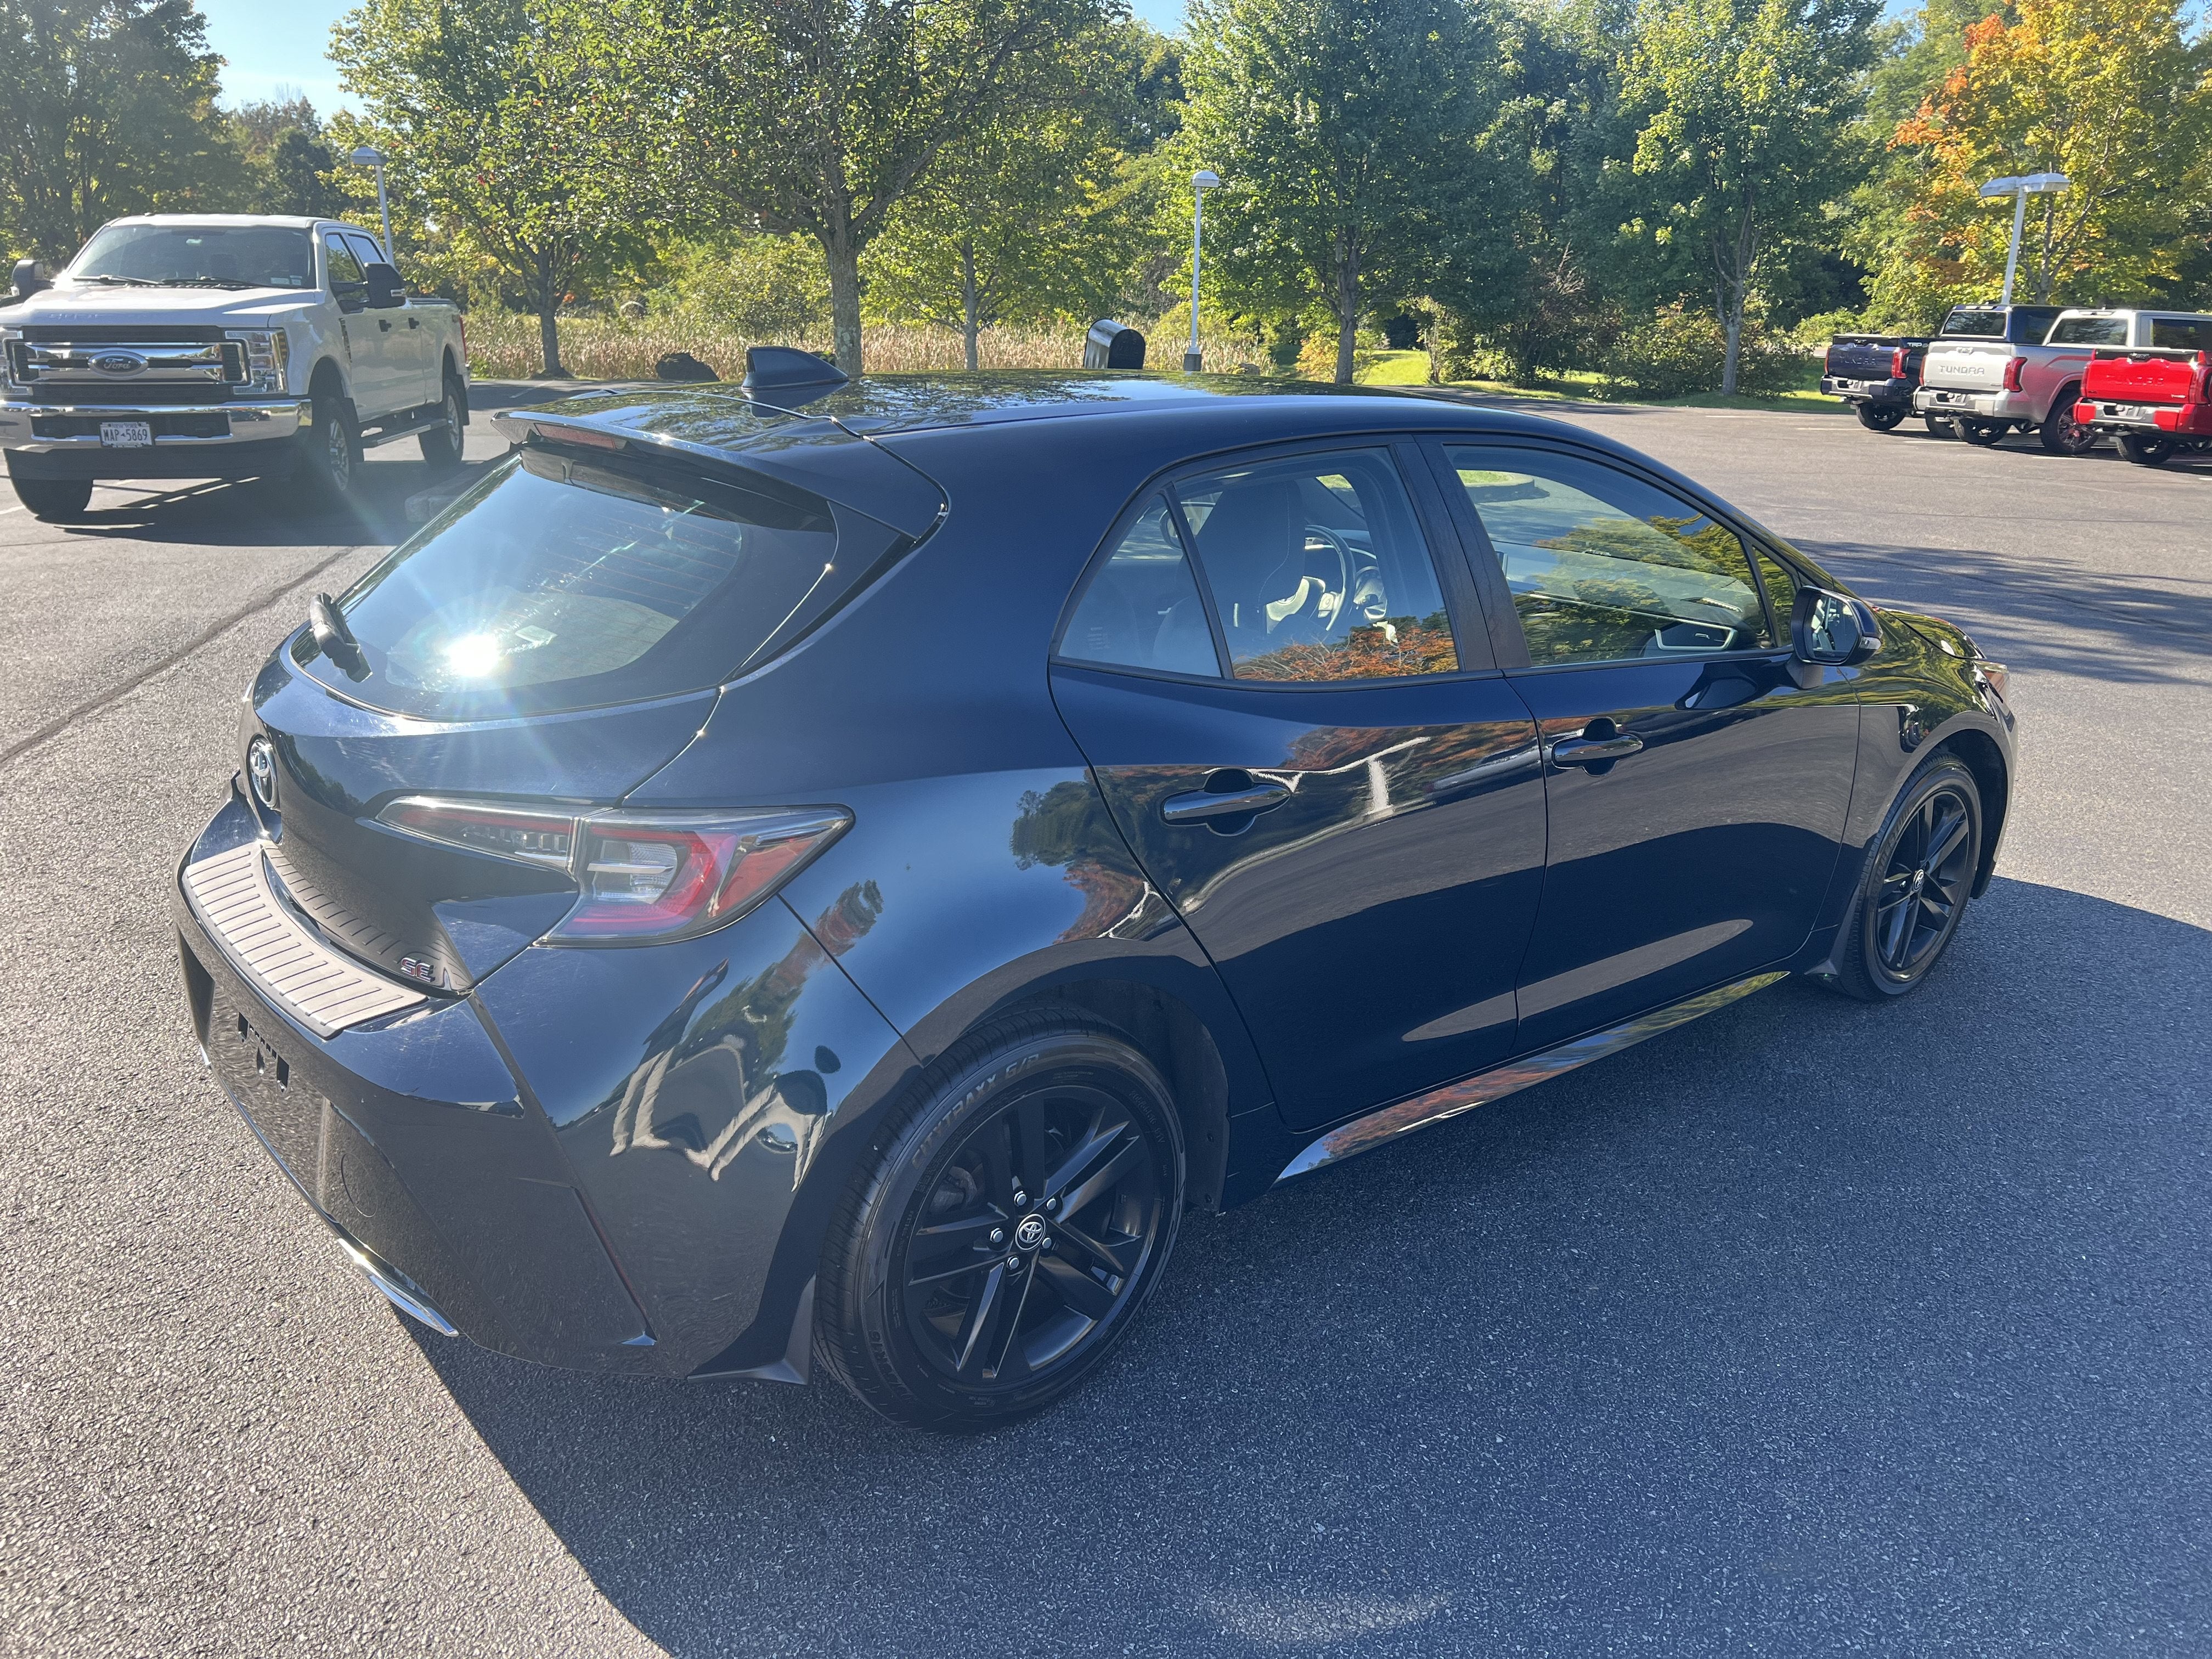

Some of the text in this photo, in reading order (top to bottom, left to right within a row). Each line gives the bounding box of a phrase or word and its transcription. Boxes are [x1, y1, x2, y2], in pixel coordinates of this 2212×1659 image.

[103, 358, 131, 369] Ford
[1939, 365, 1985, 376] TUNDRA
[401, 957, 433, 983] SE
[911, 1073, 997, 1170] CITYTRAXX
